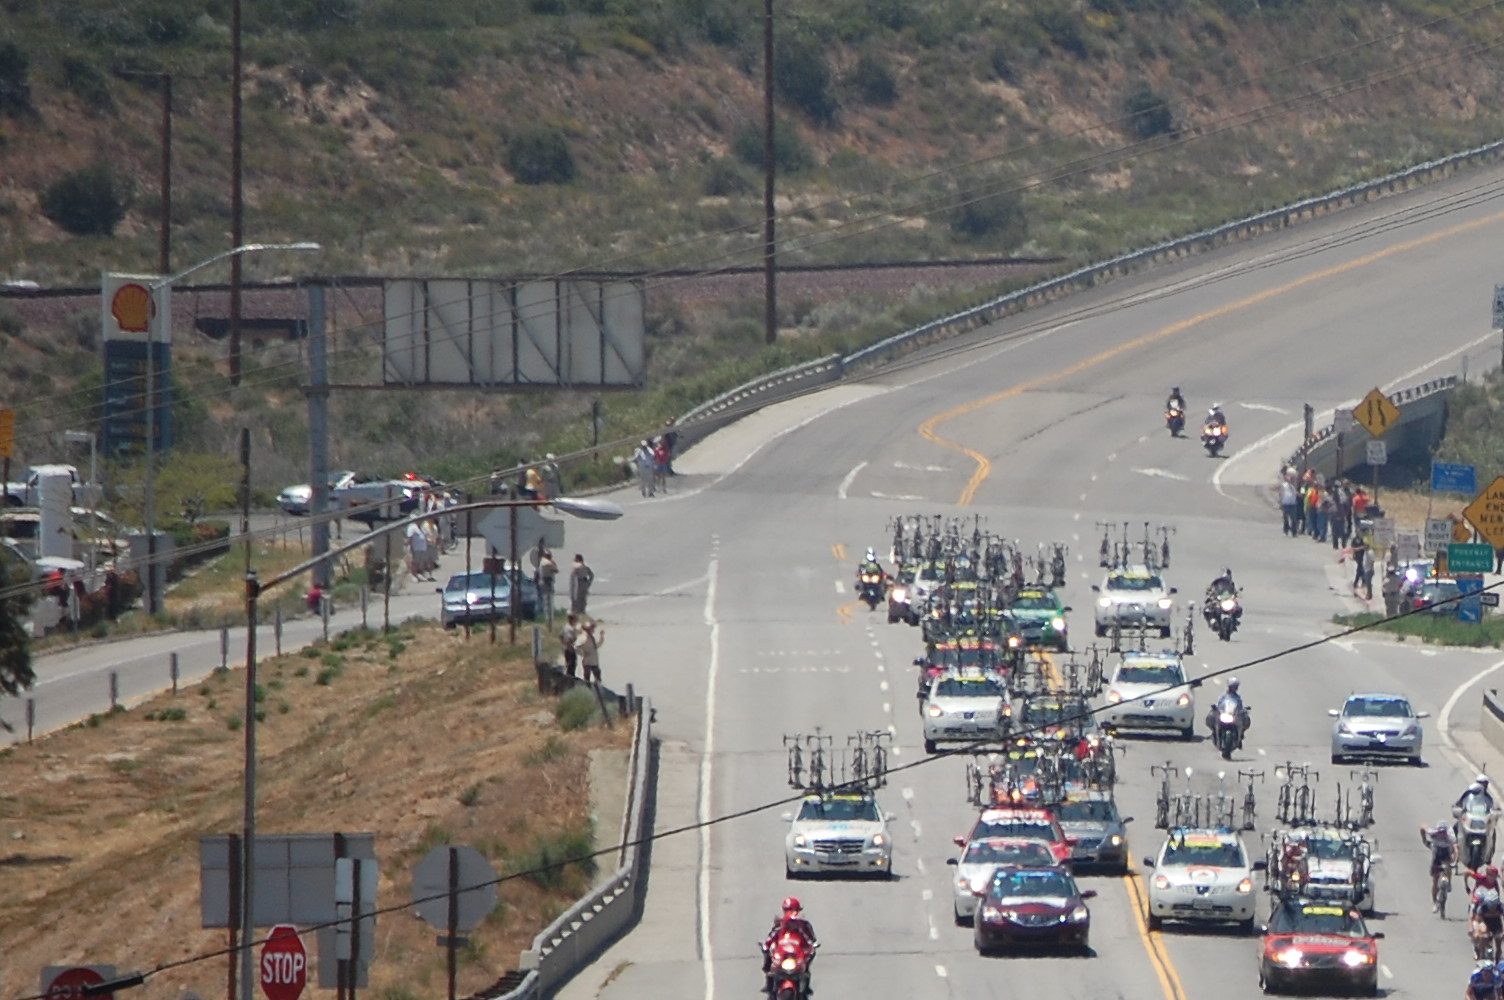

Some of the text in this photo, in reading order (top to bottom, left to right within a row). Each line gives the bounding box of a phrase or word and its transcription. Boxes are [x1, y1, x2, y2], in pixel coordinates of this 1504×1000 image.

[1432, 523, 1447, 531] NO
[1428, 532, 1450, 540] RIGHT
[1451, 560, 1490, 568] ENTRANCE
[262, 952, 304, 984] STOP
